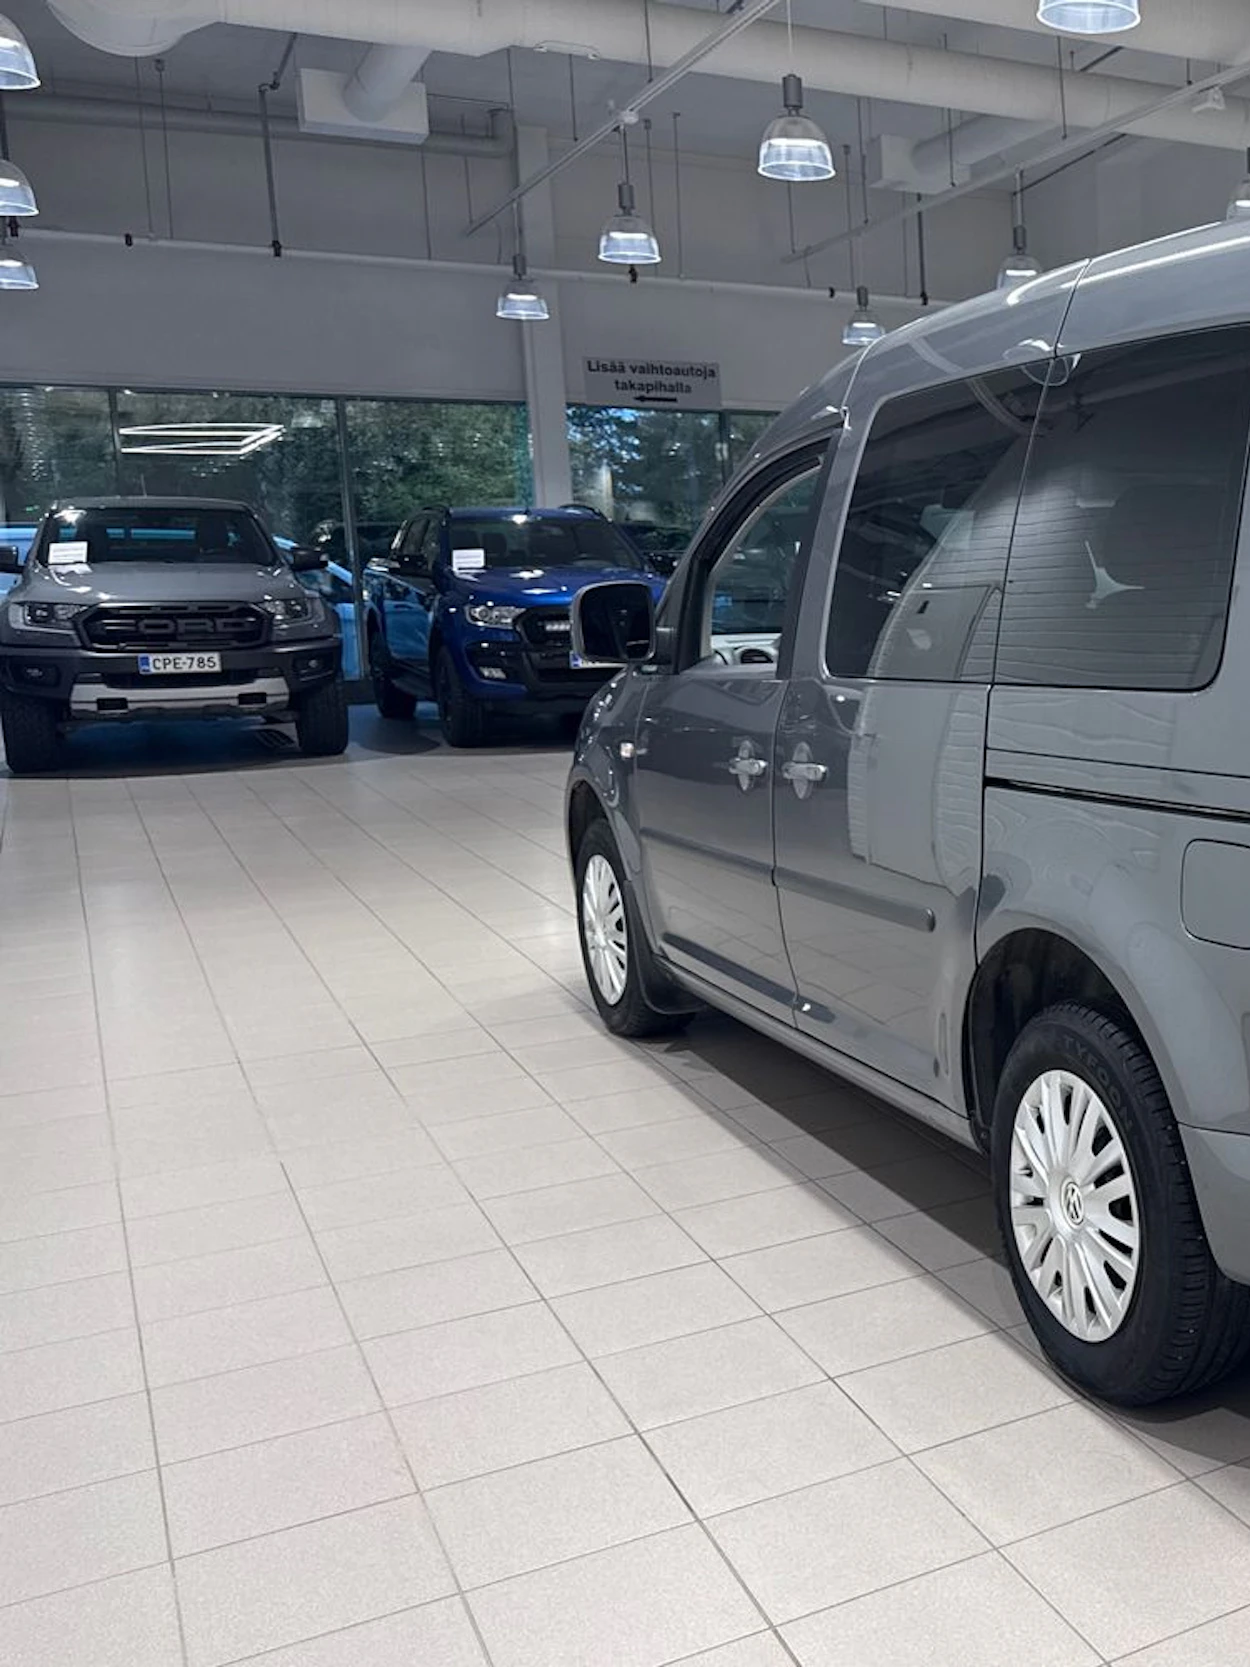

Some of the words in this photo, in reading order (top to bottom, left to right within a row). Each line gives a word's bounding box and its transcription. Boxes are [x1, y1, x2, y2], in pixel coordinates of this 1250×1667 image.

[587, 360, 626, 374] Lisää
[629, 364, 716, 379] vaihtoautoja
[614, 379, 693, 394] takapihalla
[99, 618, 257, 636] FORD
[152, 656, 217, 670] CPE-785
